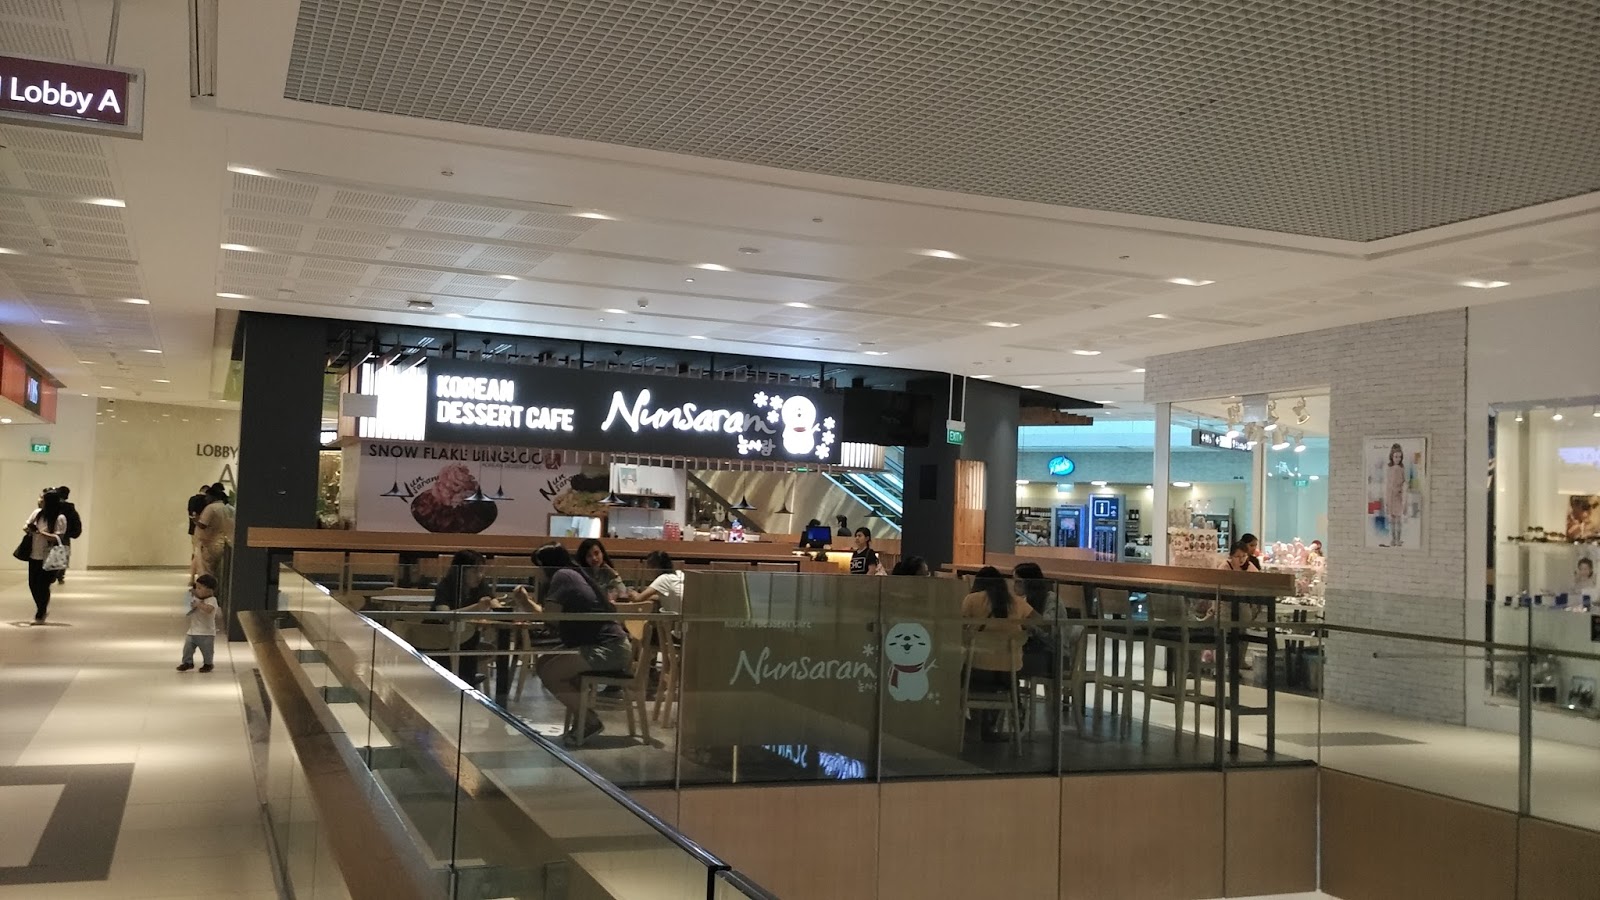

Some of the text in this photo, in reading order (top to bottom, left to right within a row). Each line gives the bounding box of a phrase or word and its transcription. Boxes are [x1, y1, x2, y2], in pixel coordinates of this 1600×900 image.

[10, 77, 94, 114] Lobby
[97, 89, 121, 113] A
[436, 375, 515, 402] KOREAN
[437, 400, 575, 431] DESSERT CAFE
[601, 388, 777, 434] Nunsaram
[197, 444, 239, 458] LOBBY
[369, 444, 418, 458] SNOW
[423, 447, 468, 461] FLAKE
[219, 464, 237, 492] A
[729, 647, 878, 685] Nunsaram
